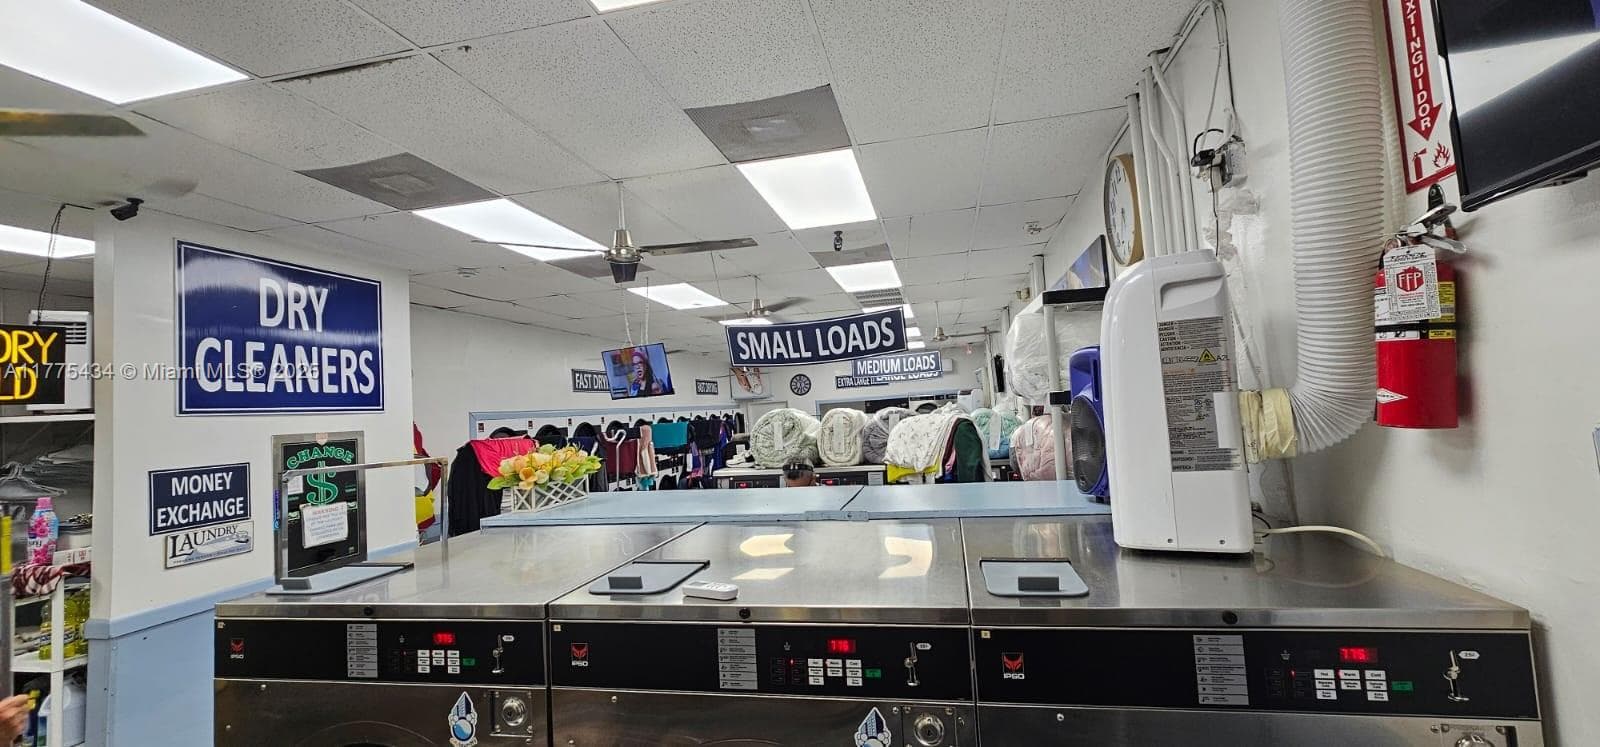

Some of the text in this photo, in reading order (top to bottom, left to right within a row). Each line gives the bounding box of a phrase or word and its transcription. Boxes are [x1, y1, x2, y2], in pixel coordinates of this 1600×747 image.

[1398, 271, 1422, 291] FFP
[259, 277, 328, 333] DRY
[737, 316, 895, 361] SMALL LOADS
[195, 337, 375, 394] CLEANERS
[857, 354, 936, 376] MEDIUM LOADS
[575, 373, 592, 389] FAST
[837, 378, 854, 388] EXTRA
[286, 445, 355, 470] CHANGE
[171, 471, 233, 496] MONEY
[156, 497, 245, 528] EXCHANGE
[168, 524, 239, 560] LAUNDRY
[1003, 672, 1025, 680] IPSO
